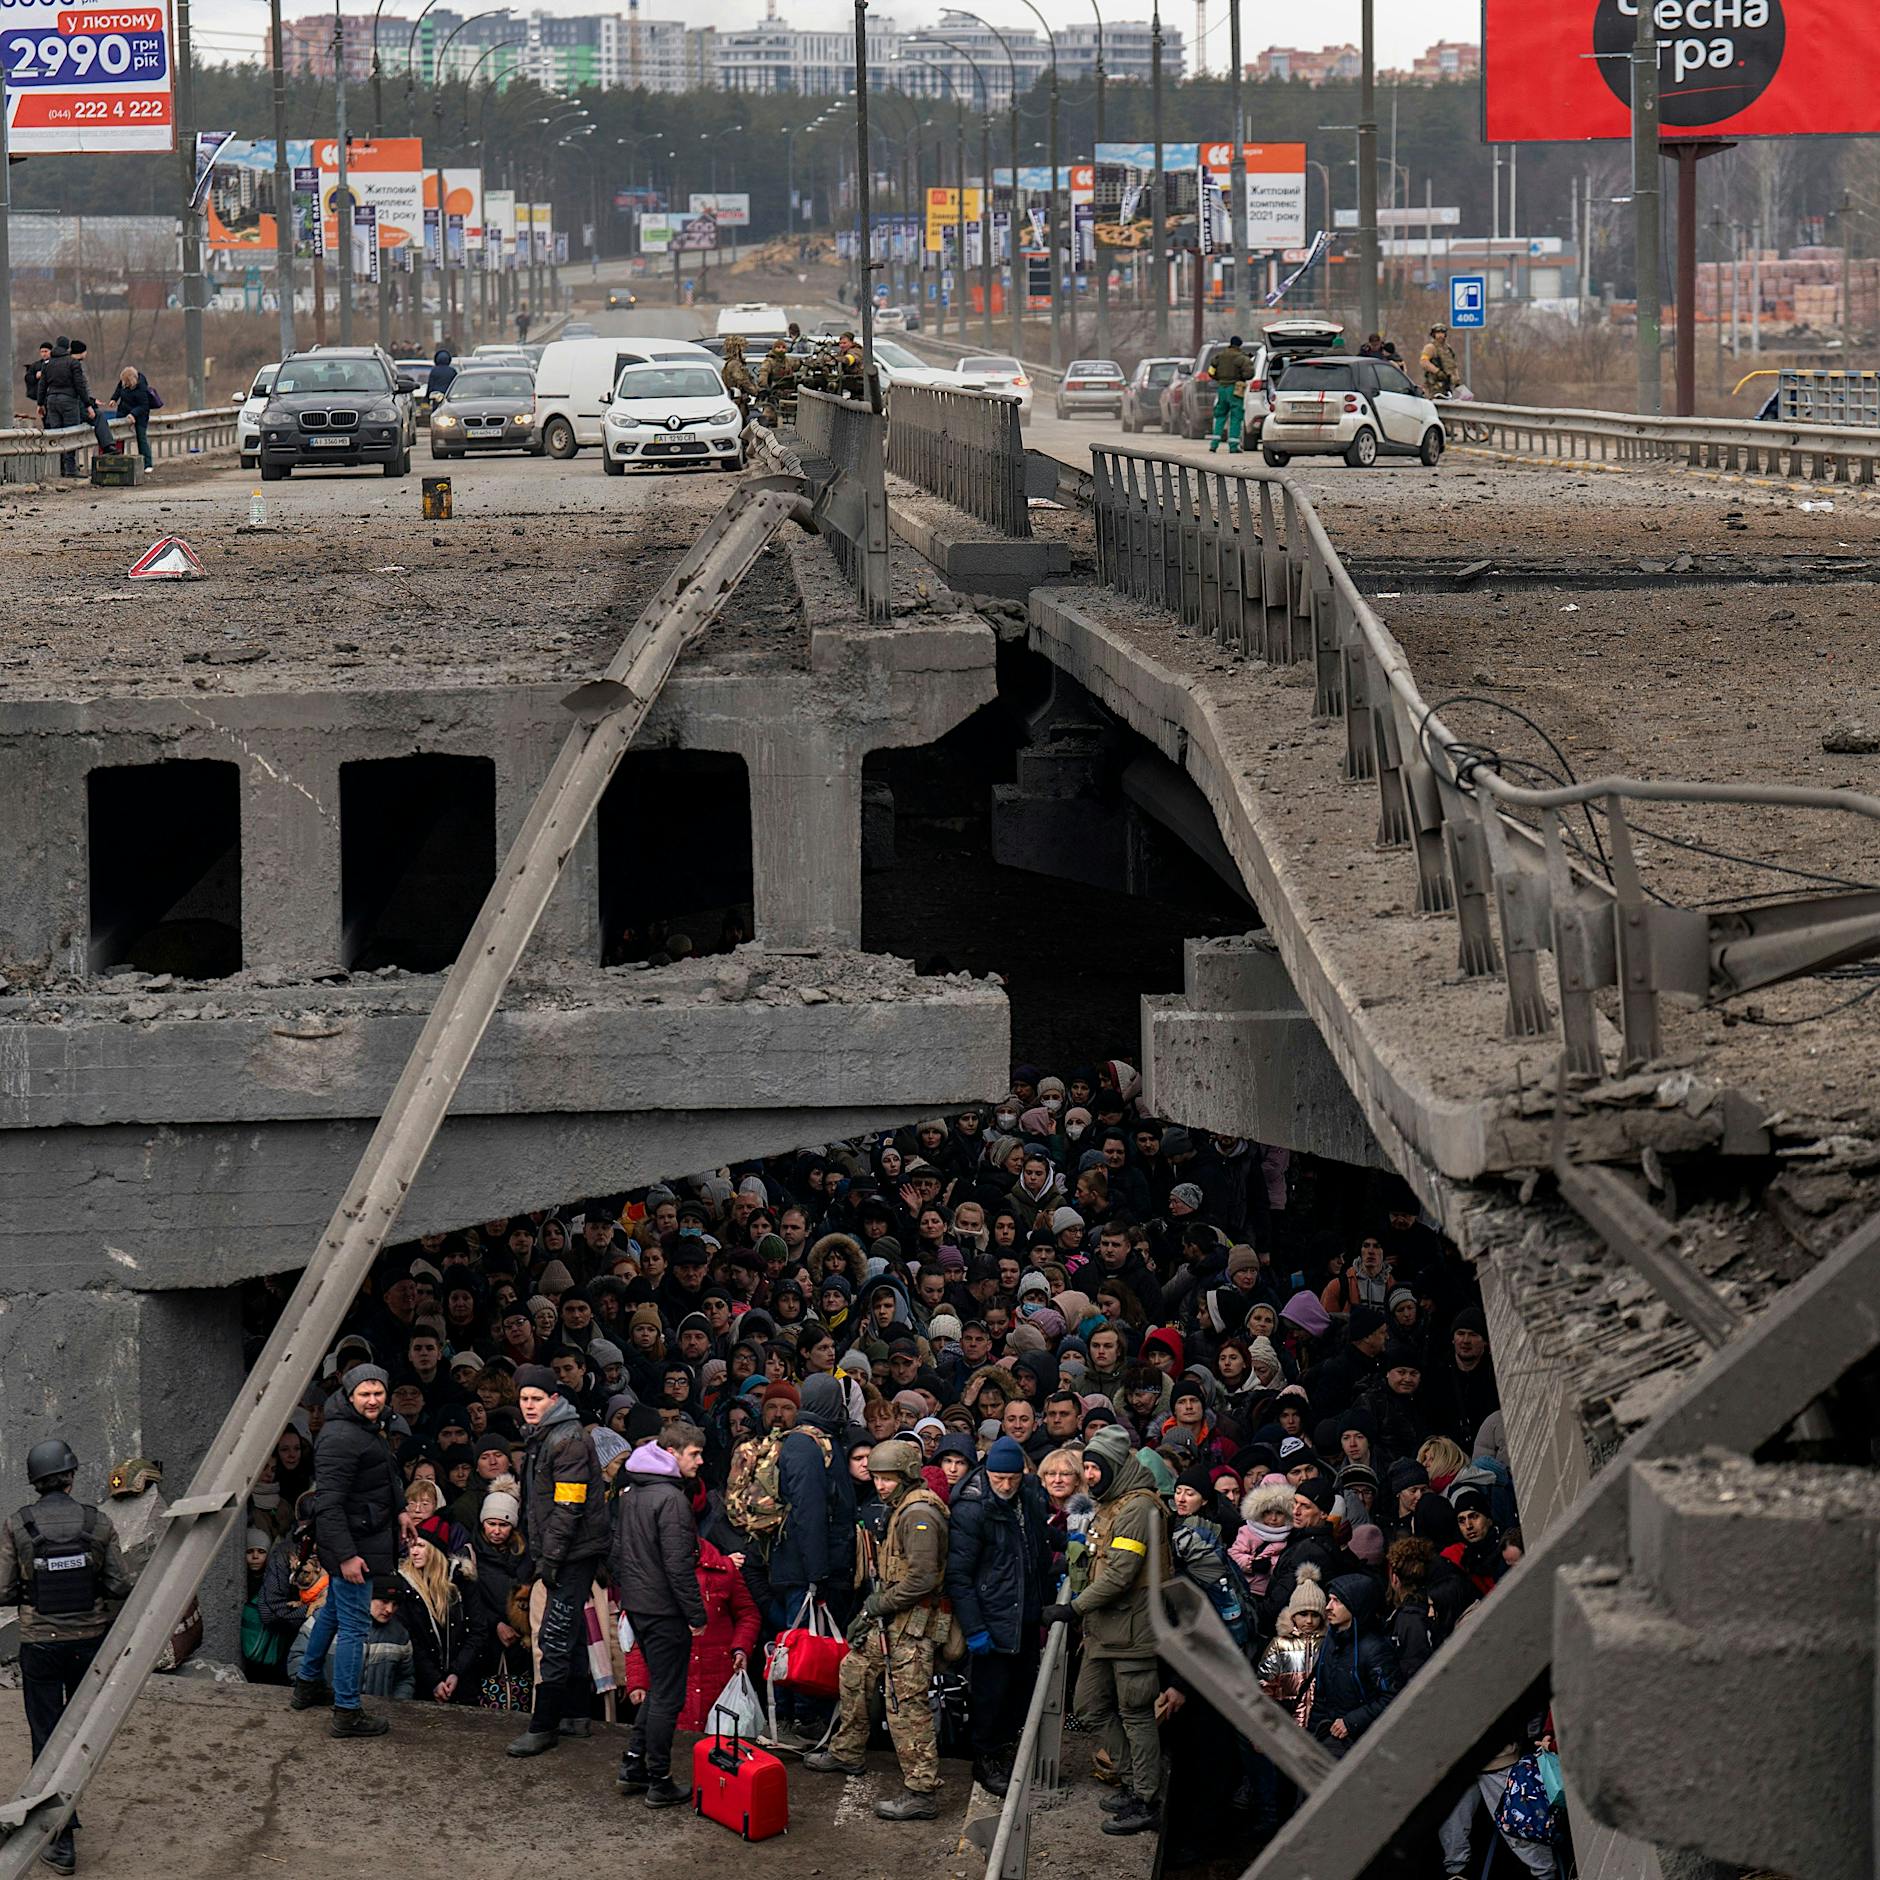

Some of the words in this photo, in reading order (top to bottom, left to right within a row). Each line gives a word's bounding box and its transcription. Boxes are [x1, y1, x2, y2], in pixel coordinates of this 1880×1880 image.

[67, 16, 78, 32] у
[82, 13, 156, 30] лютому
[1617, 0, 1769, 31] есна
[132, 38, 158, 53] грн
[9, 34, 131, 78] 2990
[134, 53, 159, 70] рік
[48, 109, 71, 120] (044)
[75, 101, 108, 118] 222
[113, 101, 125, 118] 4
[129, 100, 163, 118] 222
[1249, 184, 1301, 195] Житловий
[1249, 200, 1297, 208] комплекс
[1249, 210, 1273, 220] 2021
[1276, 212, 1301, 222] року
[51, 1558, 82, 1569] PRESS
